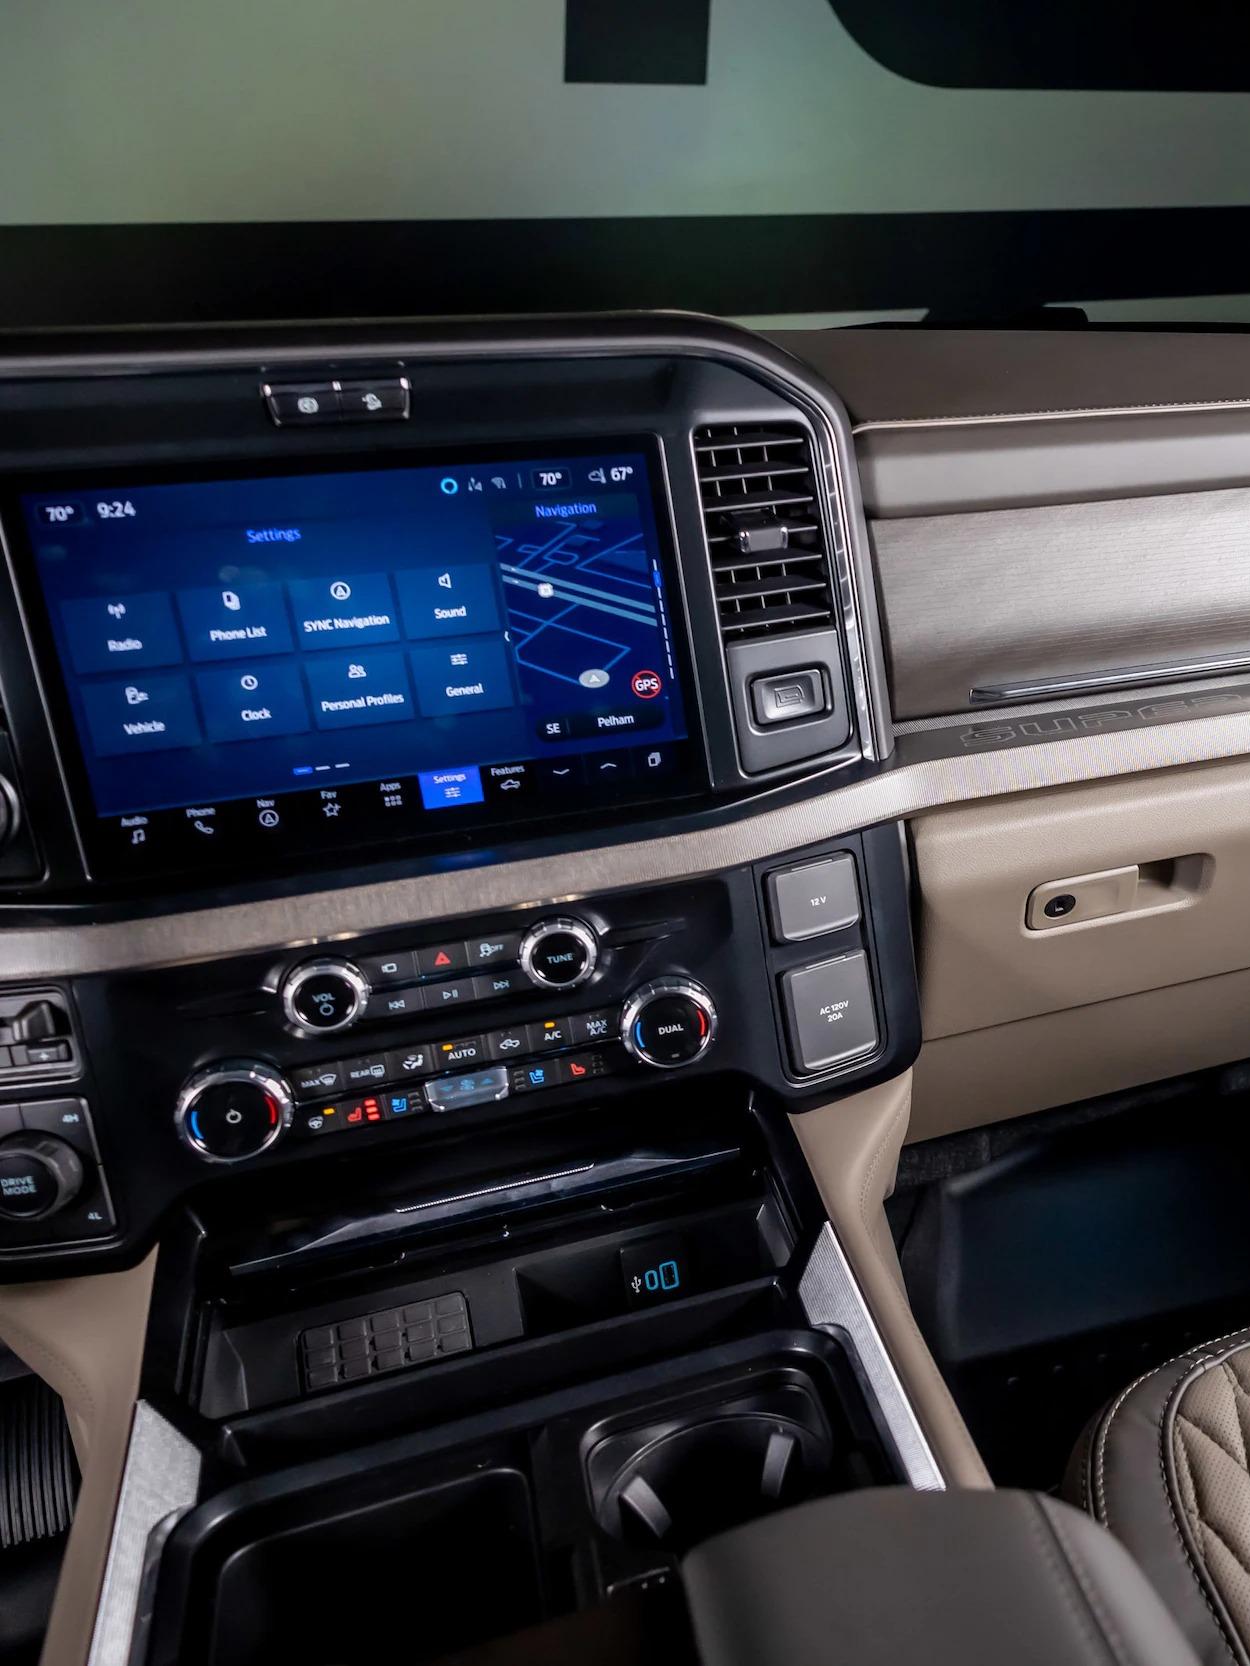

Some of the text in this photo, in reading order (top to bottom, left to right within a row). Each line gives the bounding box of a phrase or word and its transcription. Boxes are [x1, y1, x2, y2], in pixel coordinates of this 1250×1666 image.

[97, 501, 136, 518] 9:24
[535, 502, 597, 518] Navigation
[247, 528, 301, 543] Settings
[434, 606, 466, 620] Sound
[304, 614, 390, 633] SYNC Navigation
[210, 626, 267, 642] Phone List
[108, 638, 142, 651] Radio
[446, 683, 484, 698] General
[635, 678, 659, 692] GPS
[321, 692, 404, 712] Personal Profiles
[241, 708, 272, 722] Clock
[597, 714, 634, 728] Pelham
[124, 721, 165, 735] Vehicle
[546, 722, 561, 735] SE
[491, 764, 525, 777] Features
[433, 772, 466, 785] Settings
[380, 781, 401, 793] Apps
[320, 790, 337, 800] Fav
[257, 799, 275, 809] Nav
[186, 807, 216, 818] Phone
[121, 816, 148, 828] Audio
[810, 896, 827, 907] 12 V
[546, 952, 574, 965] TUNE
[312, 992, 336, 1003] VOL
[820, 1000, 849, 1016] AC 120V
[827, 1012, 843, 1023] 20A
[586, 1019, 607, 1031] MAX
[590, 1025, 607, 1036] A/C
[658, 1023, 684, 1036] DUAL
[544, 1030, 562, 1041] A/C
[448, 1048, 476, 1061] AUTO
[350, 1069, 370, 1078] REAR
[1, 1175, 34, 1187] DRIVE
[3, 1184, 36, 1195] MODE
